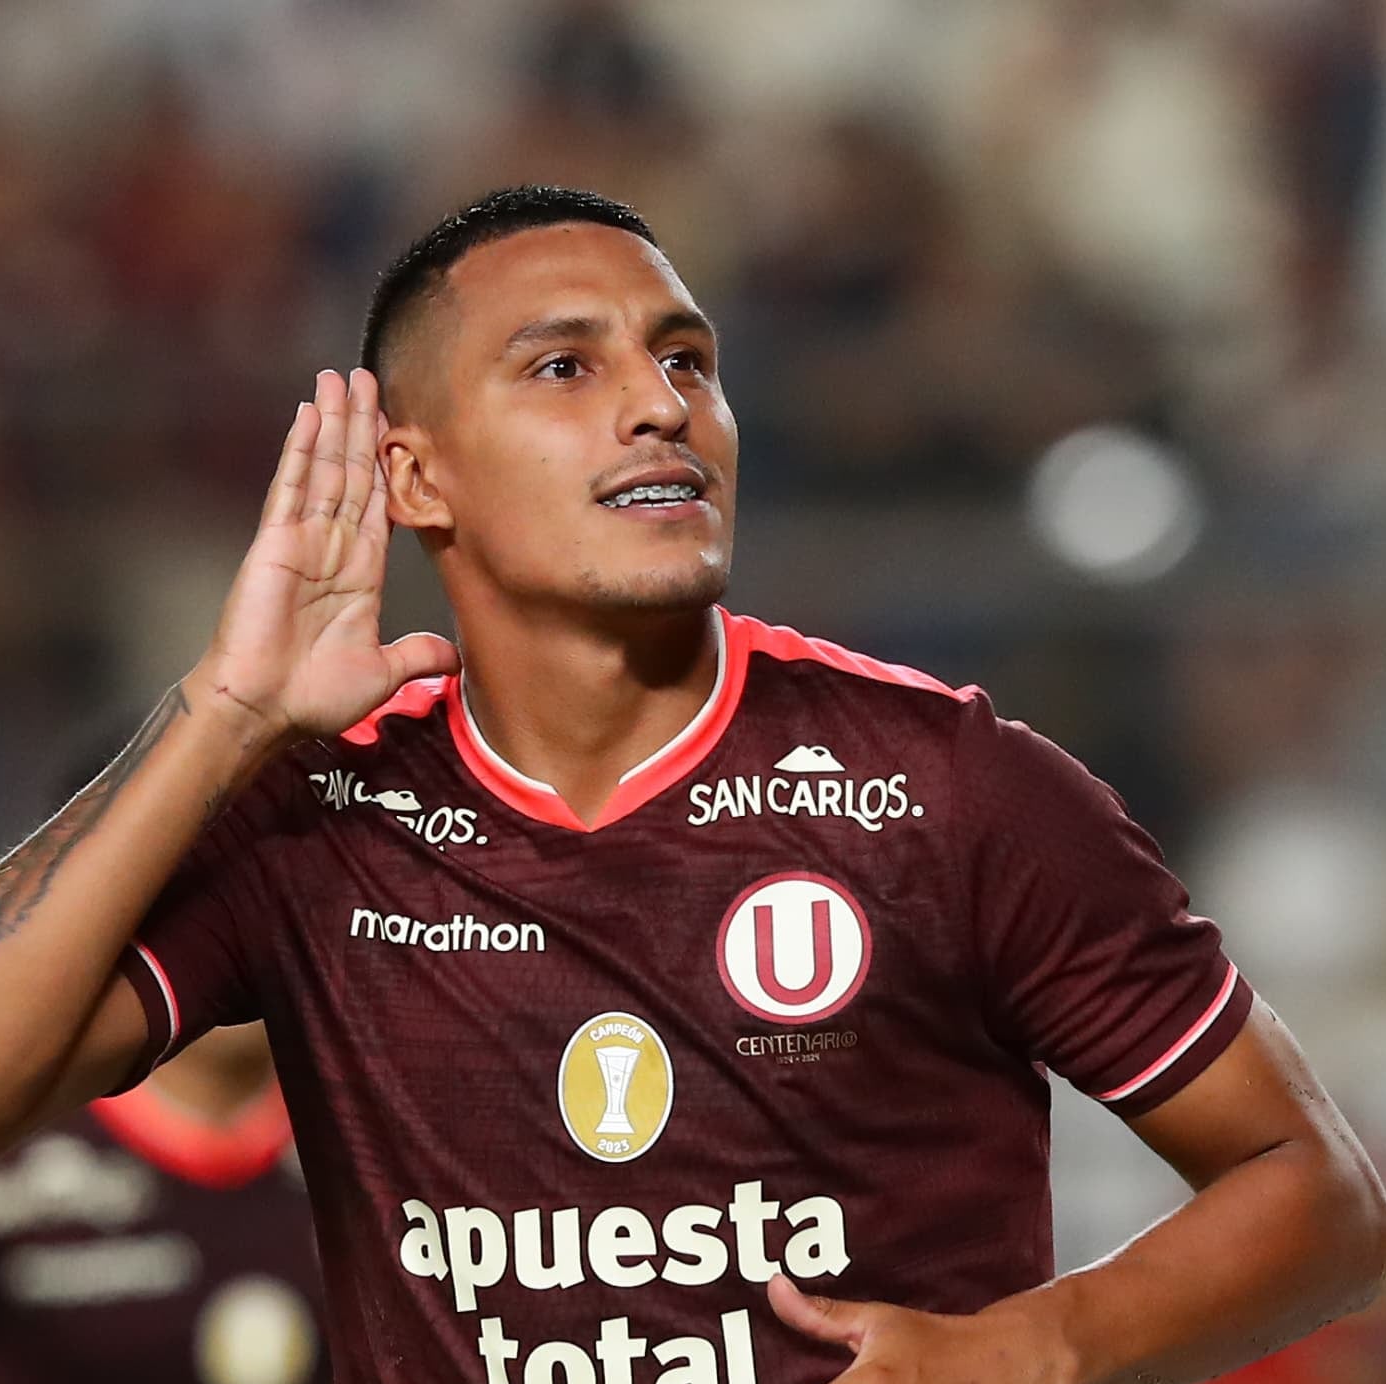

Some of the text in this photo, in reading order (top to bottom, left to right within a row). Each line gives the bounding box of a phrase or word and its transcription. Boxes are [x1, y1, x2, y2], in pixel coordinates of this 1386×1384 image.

[686, 773, 909, 832] SAN CARLOS
[349, 907, 546, 952] marathon
[753, 899, 834, 1006] U
[589, 1022, 646, 1045] CAMPEÓN
[597, 1138, 631, 1154] 2023
[399, 1179, 852, 1313] apuesta
